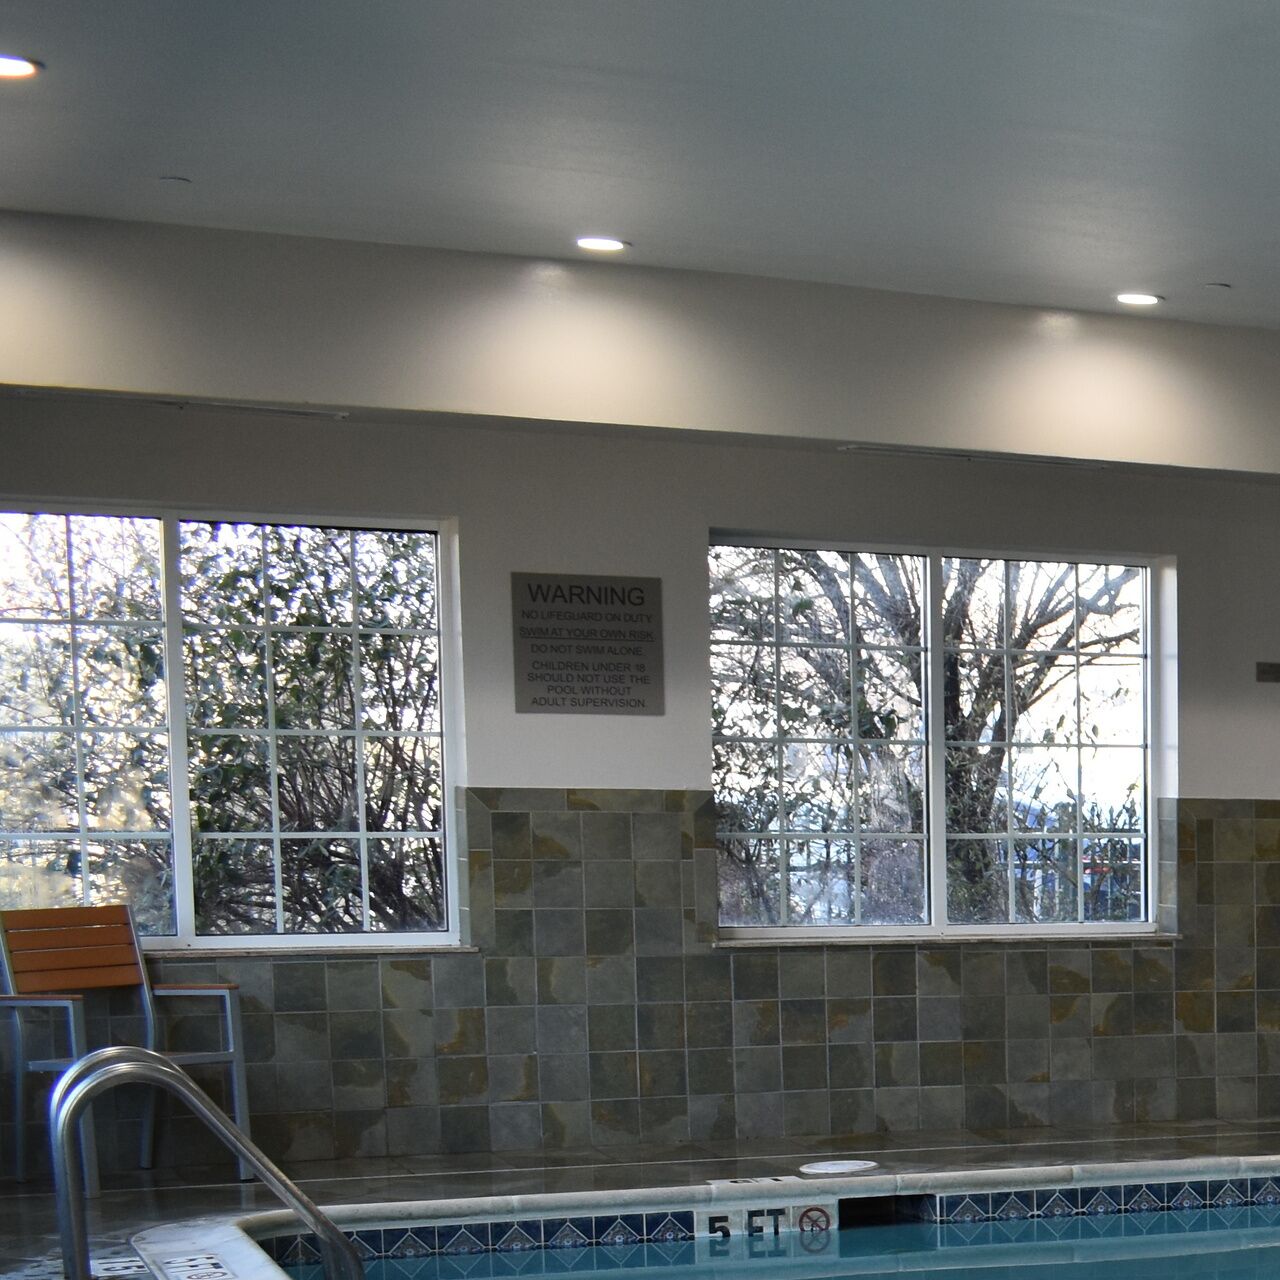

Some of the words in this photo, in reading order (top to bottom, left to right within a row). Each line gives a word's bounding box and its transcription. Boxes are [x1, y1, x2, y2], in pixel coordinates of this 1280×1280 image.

[528, 583, 645, 606] WARNING
[522, 610, 539, 620] NO
[541, 611, 603, 622] LIFEGUARD
[606, 612, 621, 622] ON
[624, 613, 652, 623] DUTY
[520, 626, 550, 636] SWIM
[551, 627, 565, 637] AT
[567, 628, 600, 638] YOUR
[600, 629, 626, 639] OWN
[628, 630, 654, 640] RISK
[531, 643, 548, 654] DO
[551, 644, 573, 654] NOT
[576, 645, 605, 655] SWIM
[607, 646, 643, 656] ALONE
[532, 661, 589, 672] CHILDREN
[592, 662, 631, 672] UNDER
[635, 663, 646, 673] 18
[527, 672, 574, 683] SHOULD
[577, 673, 600, 683] NOT
[603, 674, 625, 684] USE
[629, 675, 651, 685] THE
[547, 685, 578, 695] POOL
[581, 686, 632, 696] WITHOUT
[531, 697, 566, 707] ADULT
[570, 697, 645, 708] SUPERVISION
[708, 1215, 731, 1238] 5
[747, 1208, 786, 1237] FT
